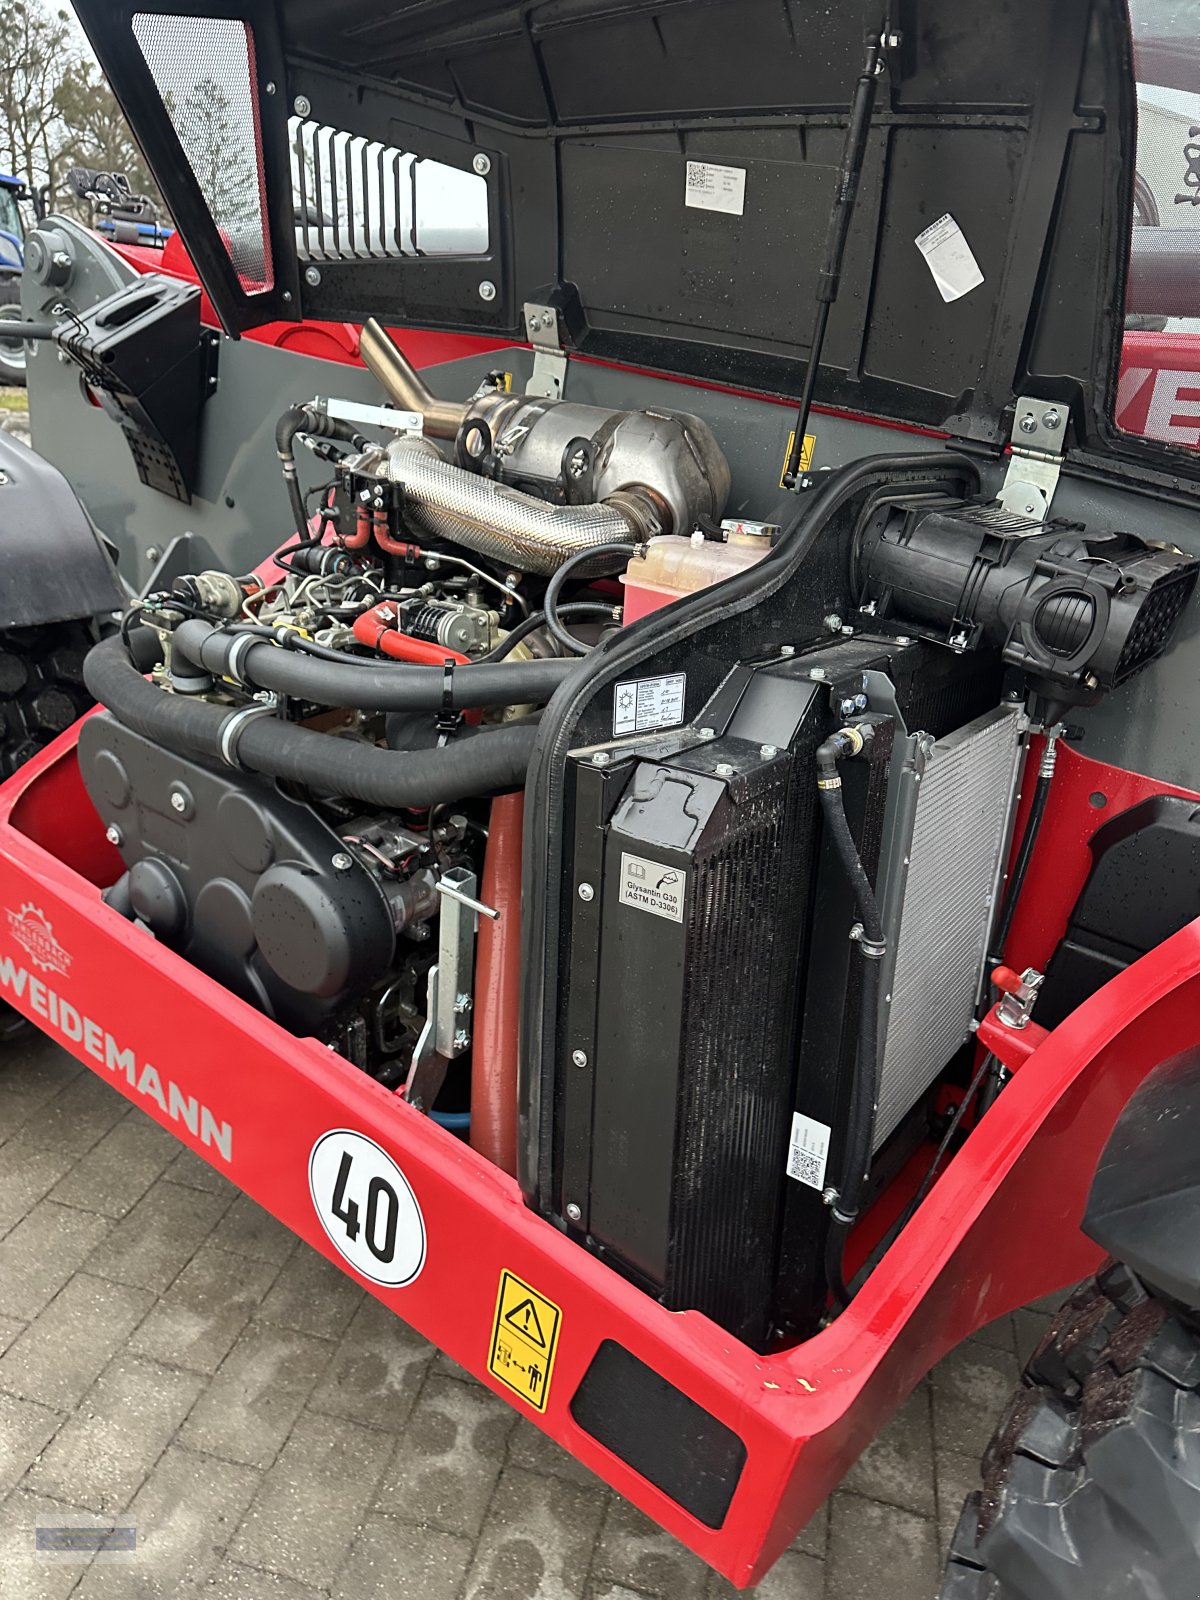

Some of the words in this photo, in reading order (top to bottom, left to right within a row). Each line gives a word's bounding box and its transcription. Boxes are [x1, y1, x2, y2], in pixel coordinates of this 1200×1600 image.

[625, 890, 649, 904] (ASTM
[650, 898, 678, 915] D-3306)
[627, 881, 661, 898] Glysantin
[662, 892, 678, 904] G30
[0, 953, 232, 1163] WEIDEMANN
[331, 1150, 399, 1264] 40
